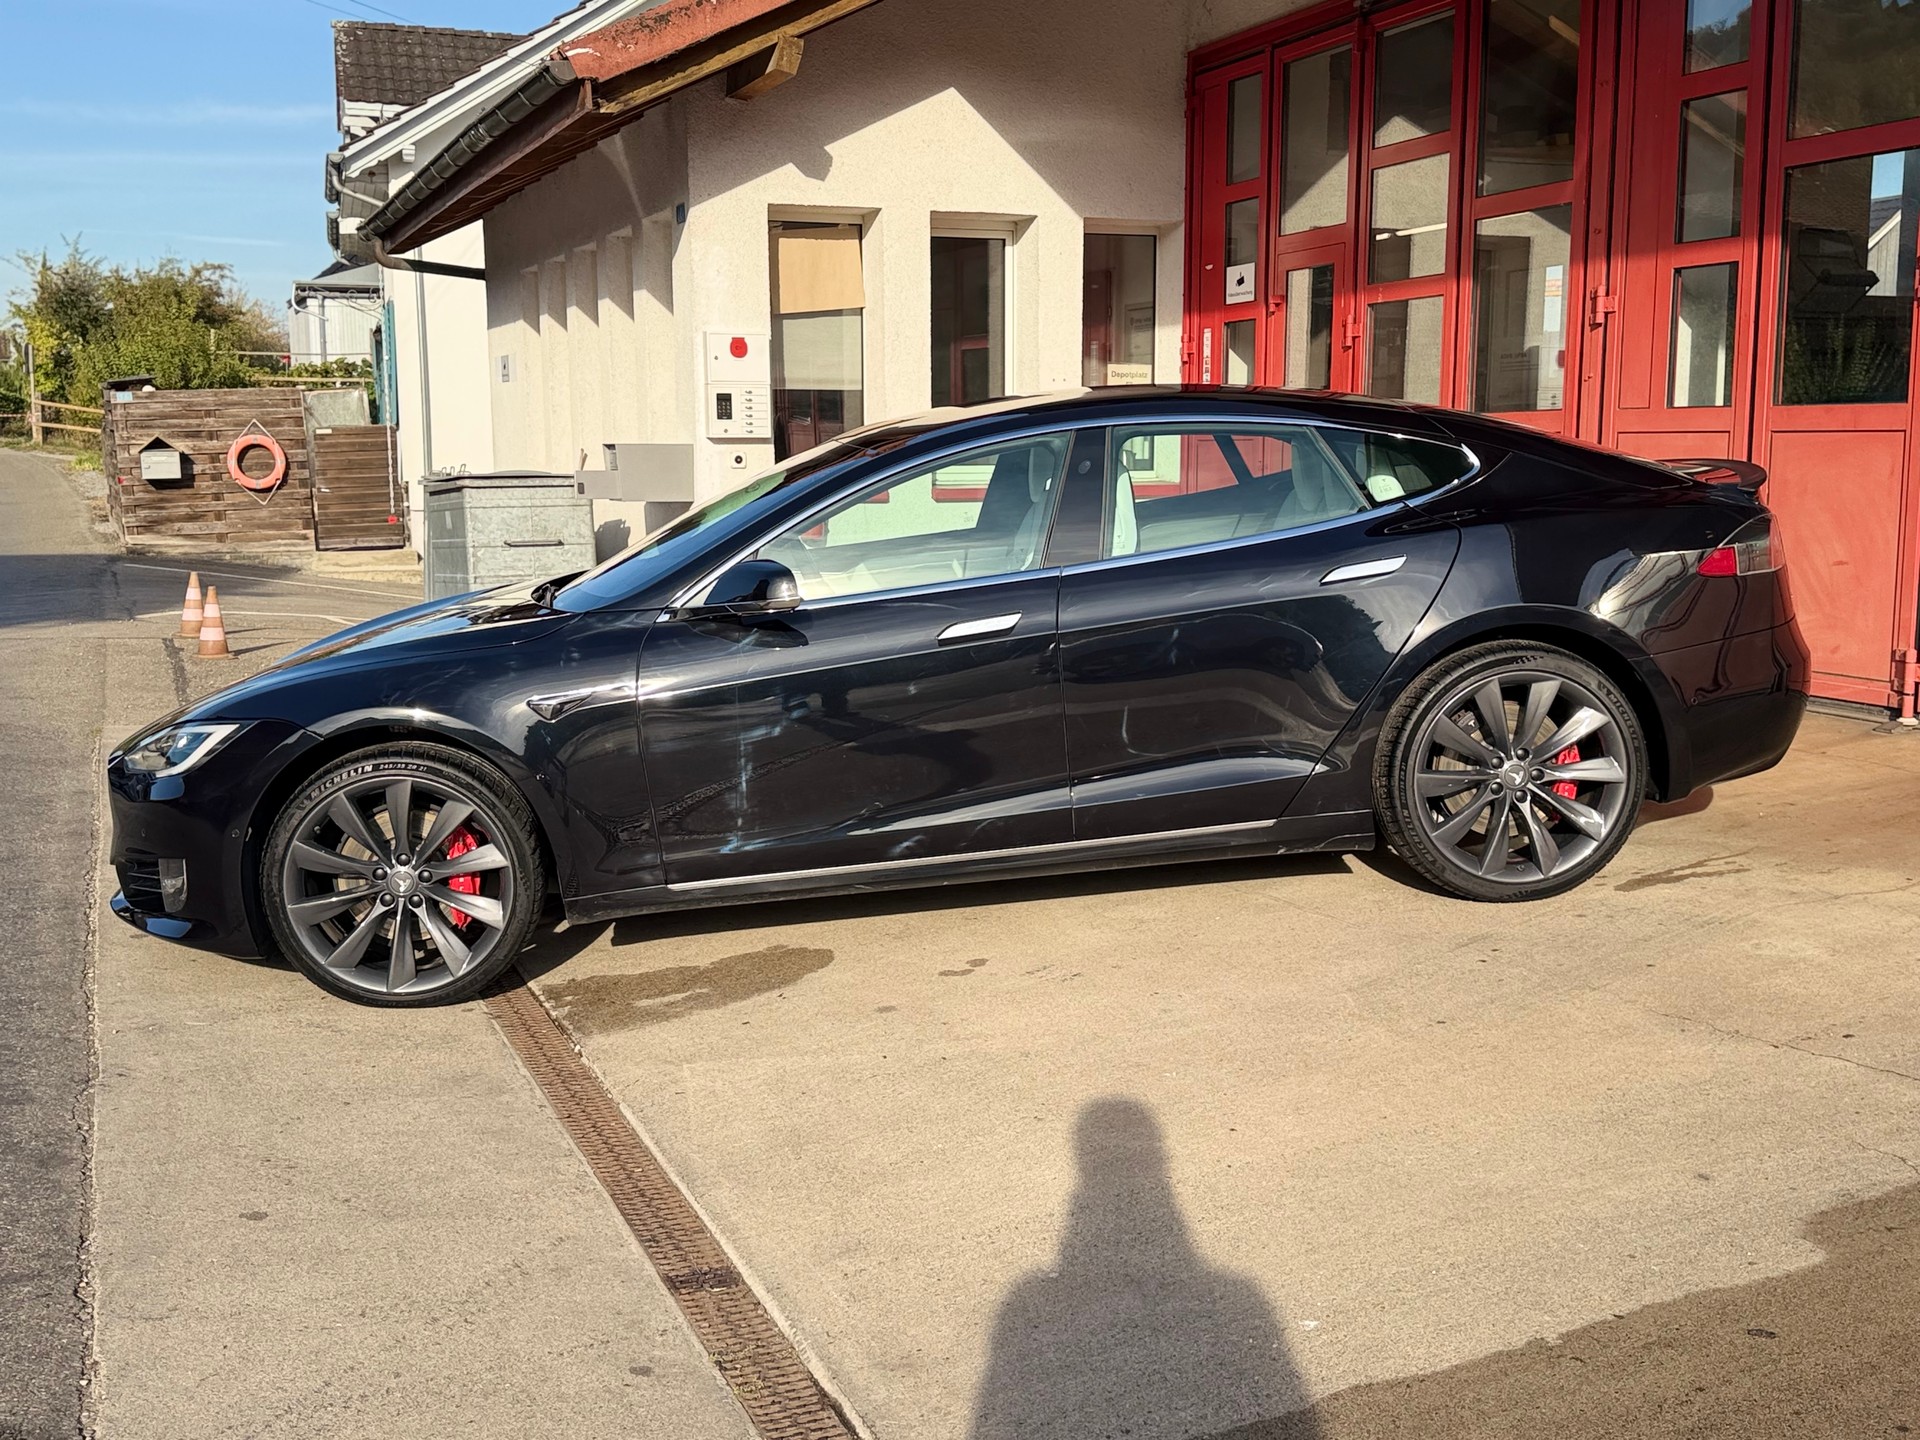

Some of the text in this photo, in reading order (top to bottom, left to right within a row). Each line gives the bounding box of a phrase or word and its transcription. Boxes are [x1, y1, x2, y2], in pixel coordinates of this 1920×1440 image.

[1111, 371, 1148, 379] Depotplatz
[1608, 694, 1640, 747] MICHELIN
[310, 764, 373, 800] MICHELIN
[1402, 808, 1434, 861] MICHELIN
